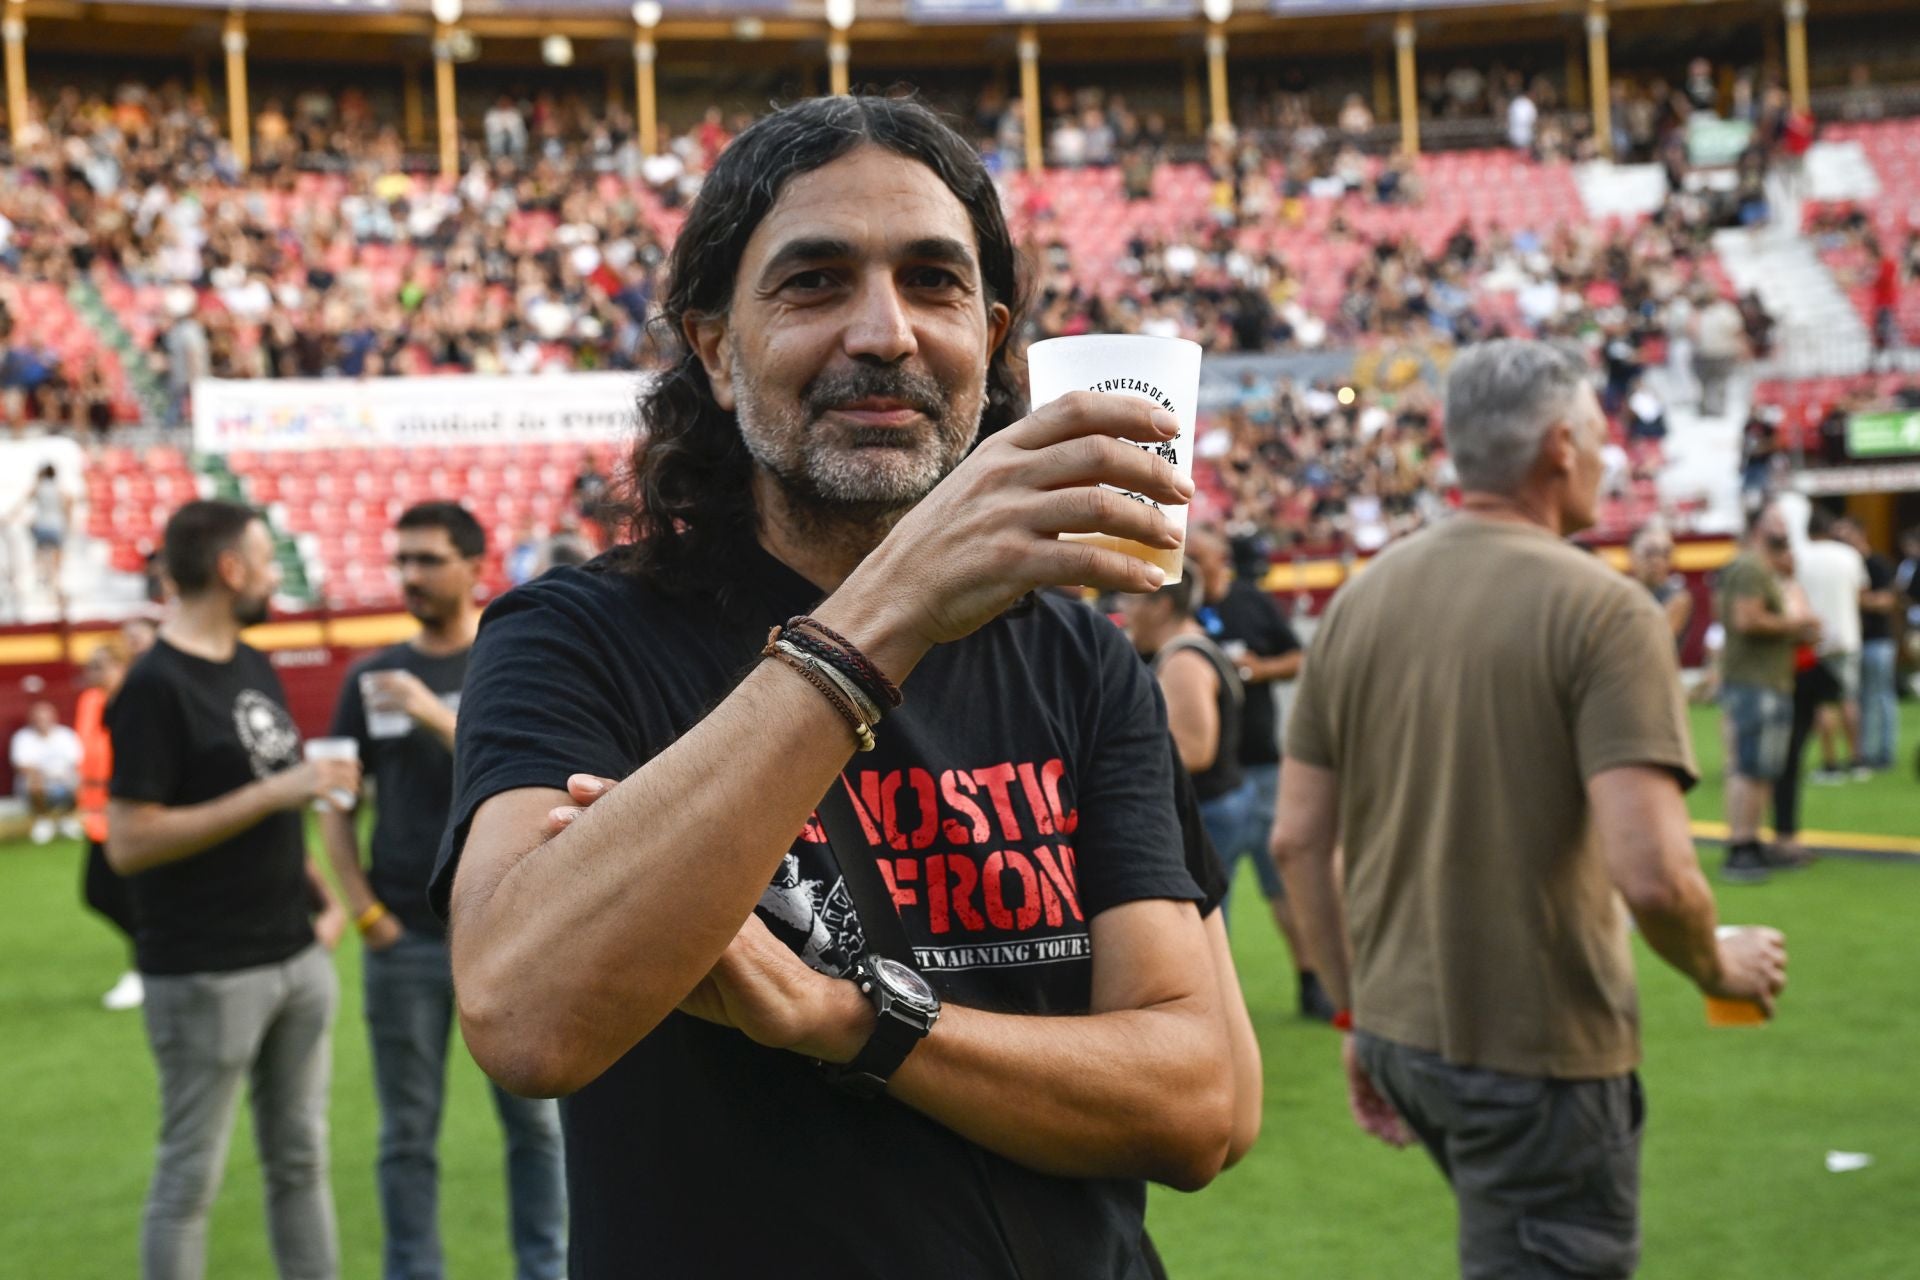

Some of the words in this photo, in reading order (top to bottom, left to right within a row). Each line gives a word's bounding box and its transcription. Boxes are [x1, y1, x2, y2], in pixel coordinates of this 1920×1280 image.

[1149, 386, 1164, 402] DE
[800, 758, 1078, 850] NOSTIC
[875, 844, 1084, 934] FRON
[931, 944, 1030, 967] WARNING
[1035, 938, 1082, 961] TOUR
